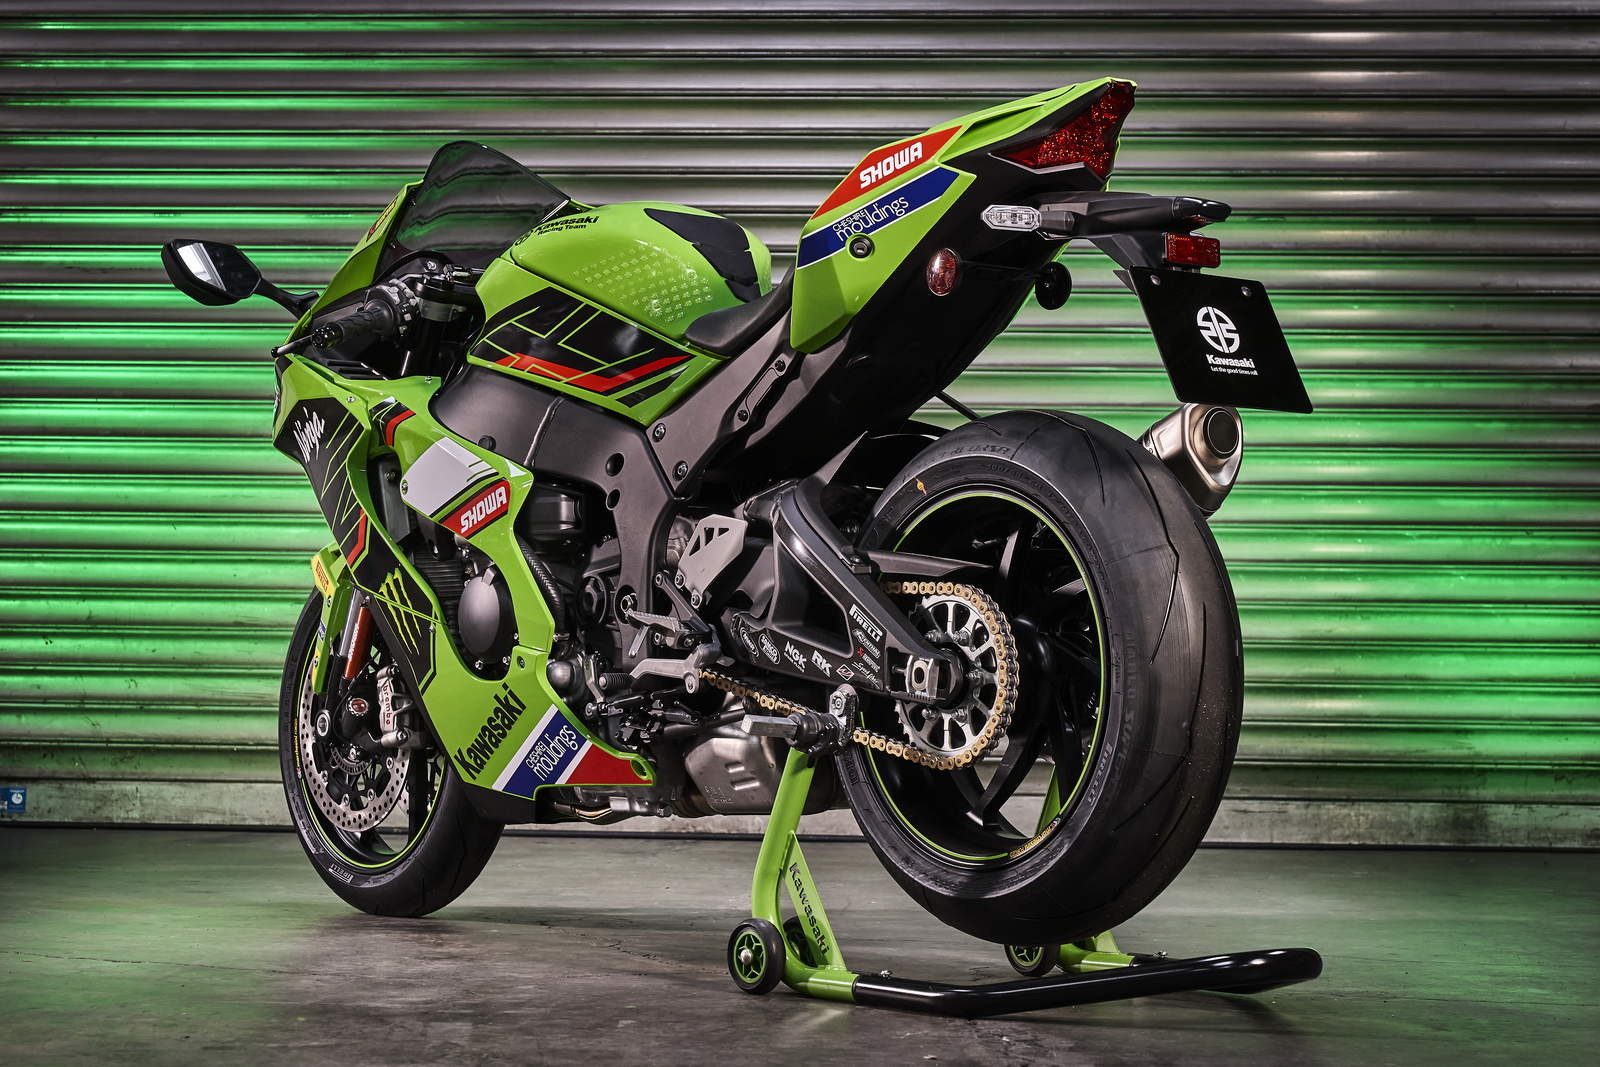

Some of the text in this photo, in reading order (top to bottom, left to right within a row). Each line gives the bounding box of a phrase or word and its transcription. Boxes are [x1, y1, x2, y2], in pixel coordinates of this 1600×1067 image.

[859, 141, 923, 189] SHOWA
[534, 216, 600, 233] Kawasaki
[537, 226, 563, 235] Racing
[832, 209, 866, 231] CHESHIRE
[836, 196, 909, 241] mouldings
[1206, 353, 1255, 368] Kawasaki
[293, 406, 325, 464] Ninja
[460, 486, 507, 533] SHOWA
[849, 603, 883, 642] PIRELLI
[784, 641, 806, 669] NGK
[811, 649, 832, 678] RK
[382, 684, 393, 725] brembo
[454, 682, 526, 780] Kawasaki
[533, 724, 578, 781] mouldings
[328, 863, 354, 884] PIRELLI
[789, 862, 830, 954] Kawasaki
